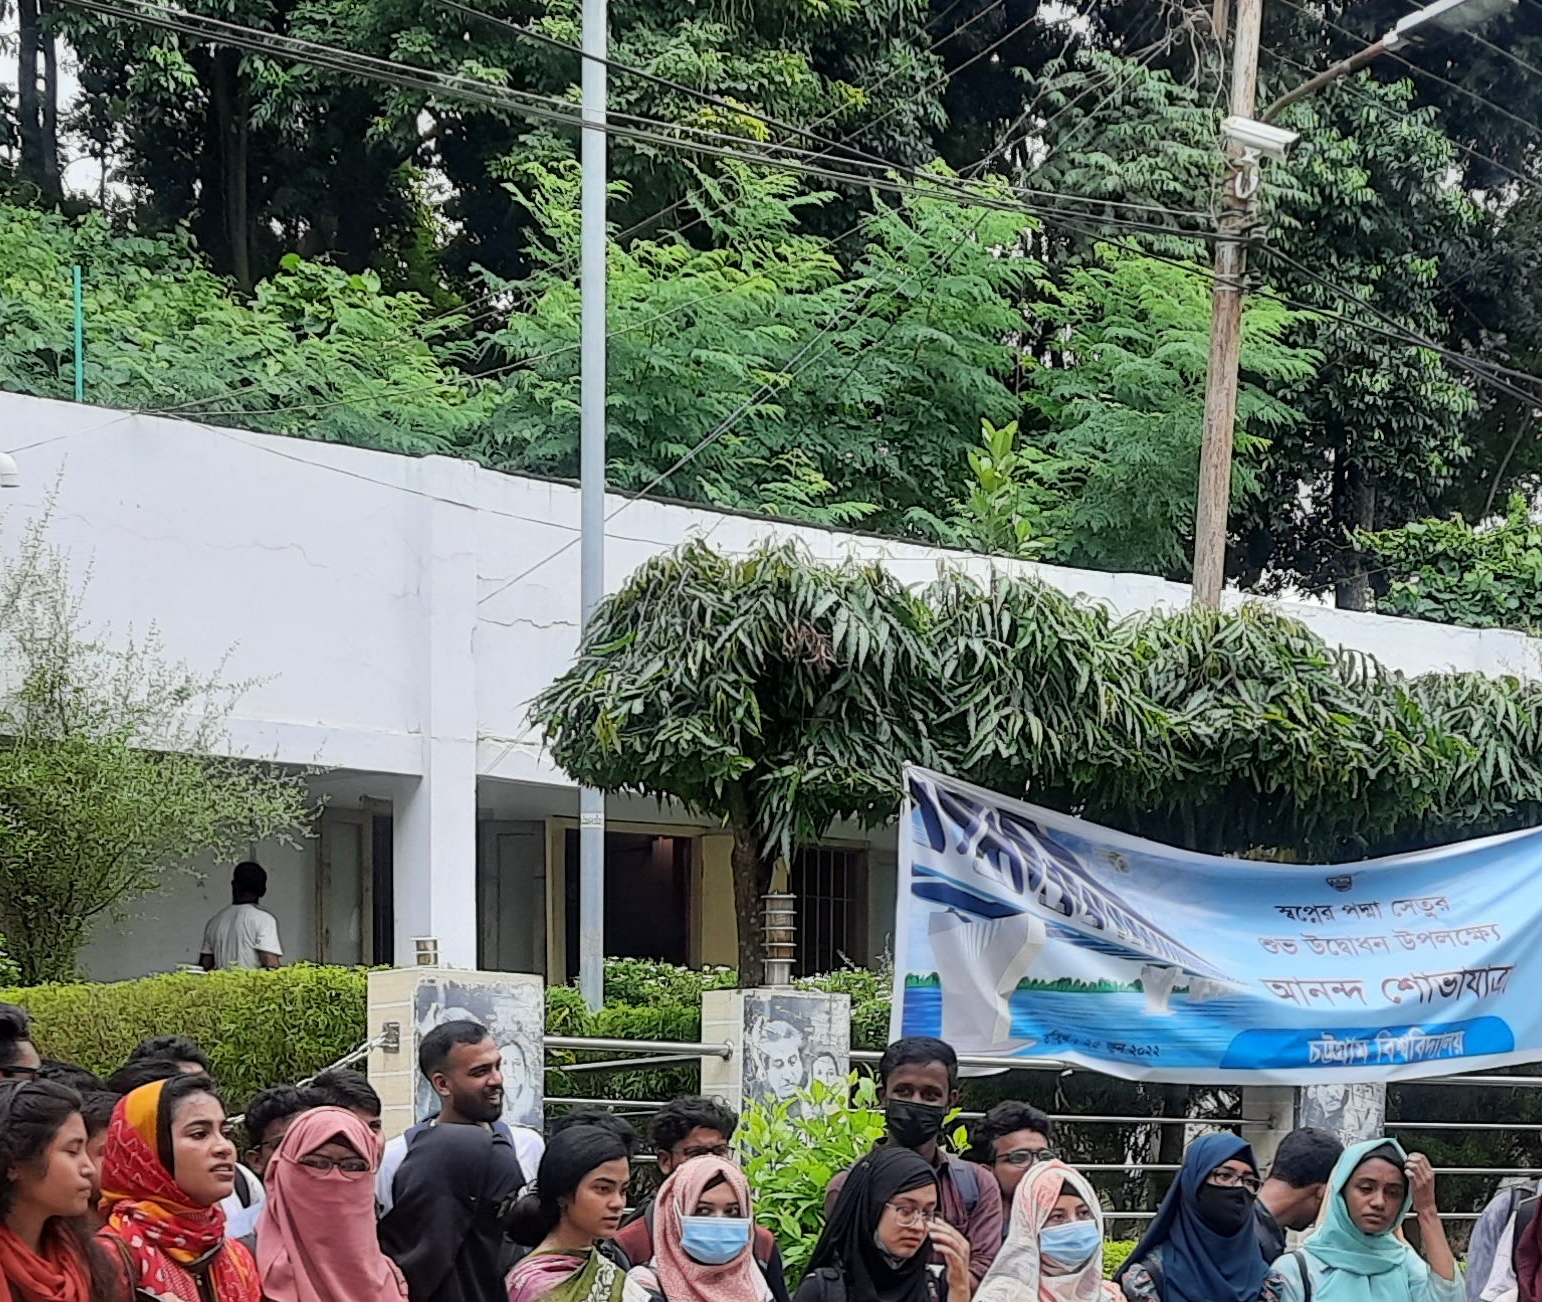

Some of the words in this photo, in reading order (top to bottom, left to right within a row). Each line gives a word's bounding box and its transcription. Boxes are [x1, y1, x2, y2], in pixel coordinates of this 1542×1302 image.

[1274, 903, 1336, 925] স্বপ্নের
[1342, 901, 1382, 919] পদ্মা
[1391, 896, 1450, 918] সেতুর
[1258, 936, 1298, 955] শুভ
[1301, 932, 1390, 957] উদ্বোধন
[1259, 976, 1368, 1007] আনন্দ
[1381, 962, 1517, 1005] শোভাযাত্রা
[1129, 1044, 1161, 1057] ২০২২
[1307, 1032, 1370, 1065] চট্টগ্রাম
[1374, 1027, 1466, 1064] বিশ্ববিদ্যালয়
